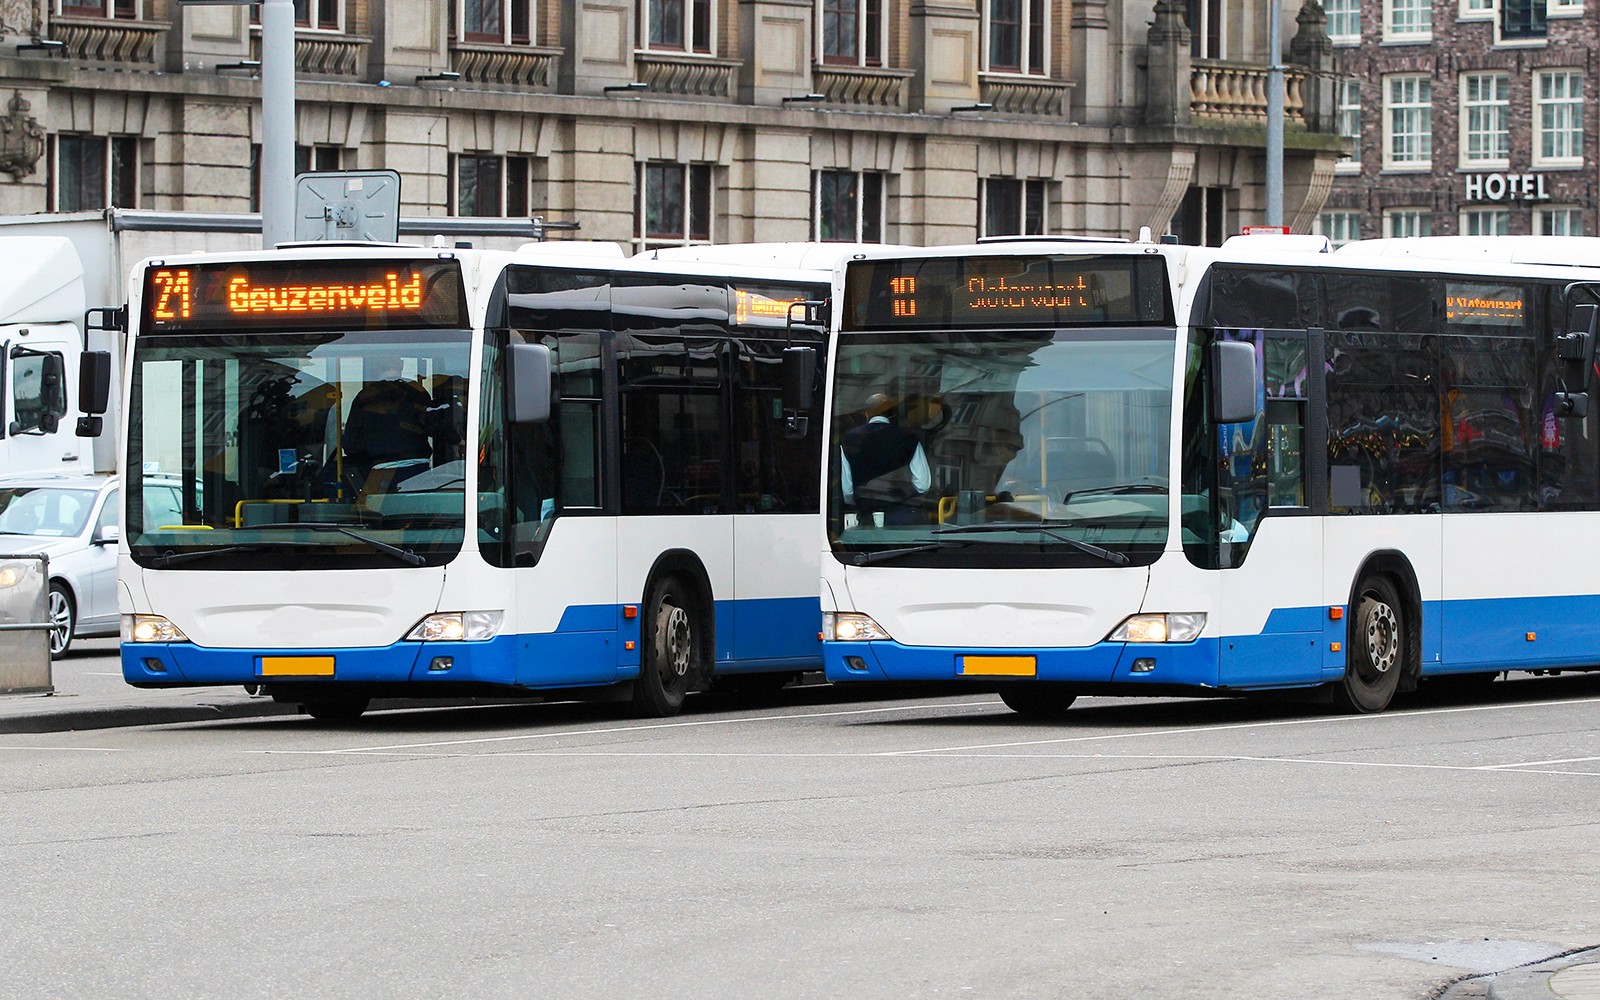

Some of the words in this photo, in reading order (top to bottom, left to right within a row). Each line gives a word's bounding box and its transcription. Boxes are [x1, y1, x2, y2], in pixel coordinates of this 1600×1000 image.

[1465, 173, 1550, 200] HOTEL
[154, 271, 190, 318] 21
[229, 272, 421, 312] Geuzenveld
